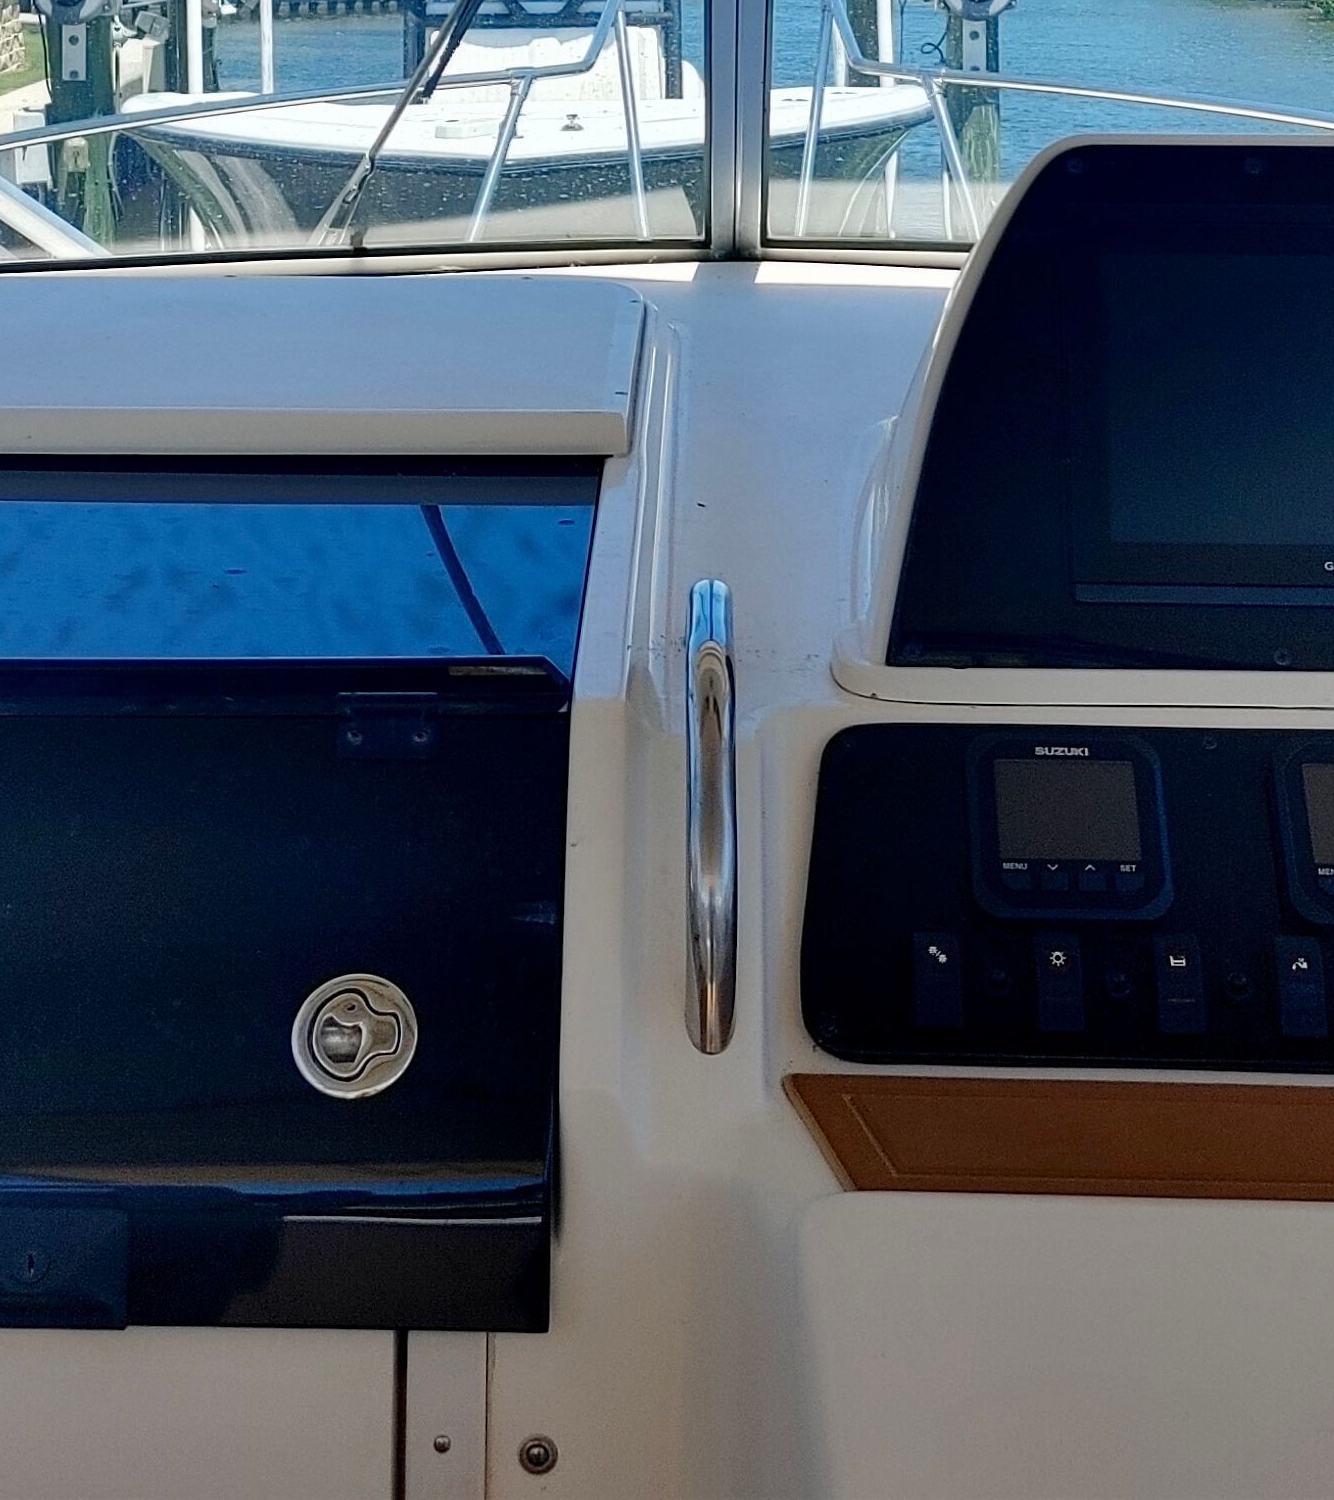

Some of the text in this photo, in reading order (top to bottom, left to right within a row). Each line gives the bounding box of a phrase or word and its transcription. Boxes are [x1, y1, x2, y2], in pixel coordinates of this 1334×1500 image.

[1034, 746, 1089, 756] SUZUKI
[1002, 862, 1028, 870] MENU
[1120, 864, 1137, 872] SET
